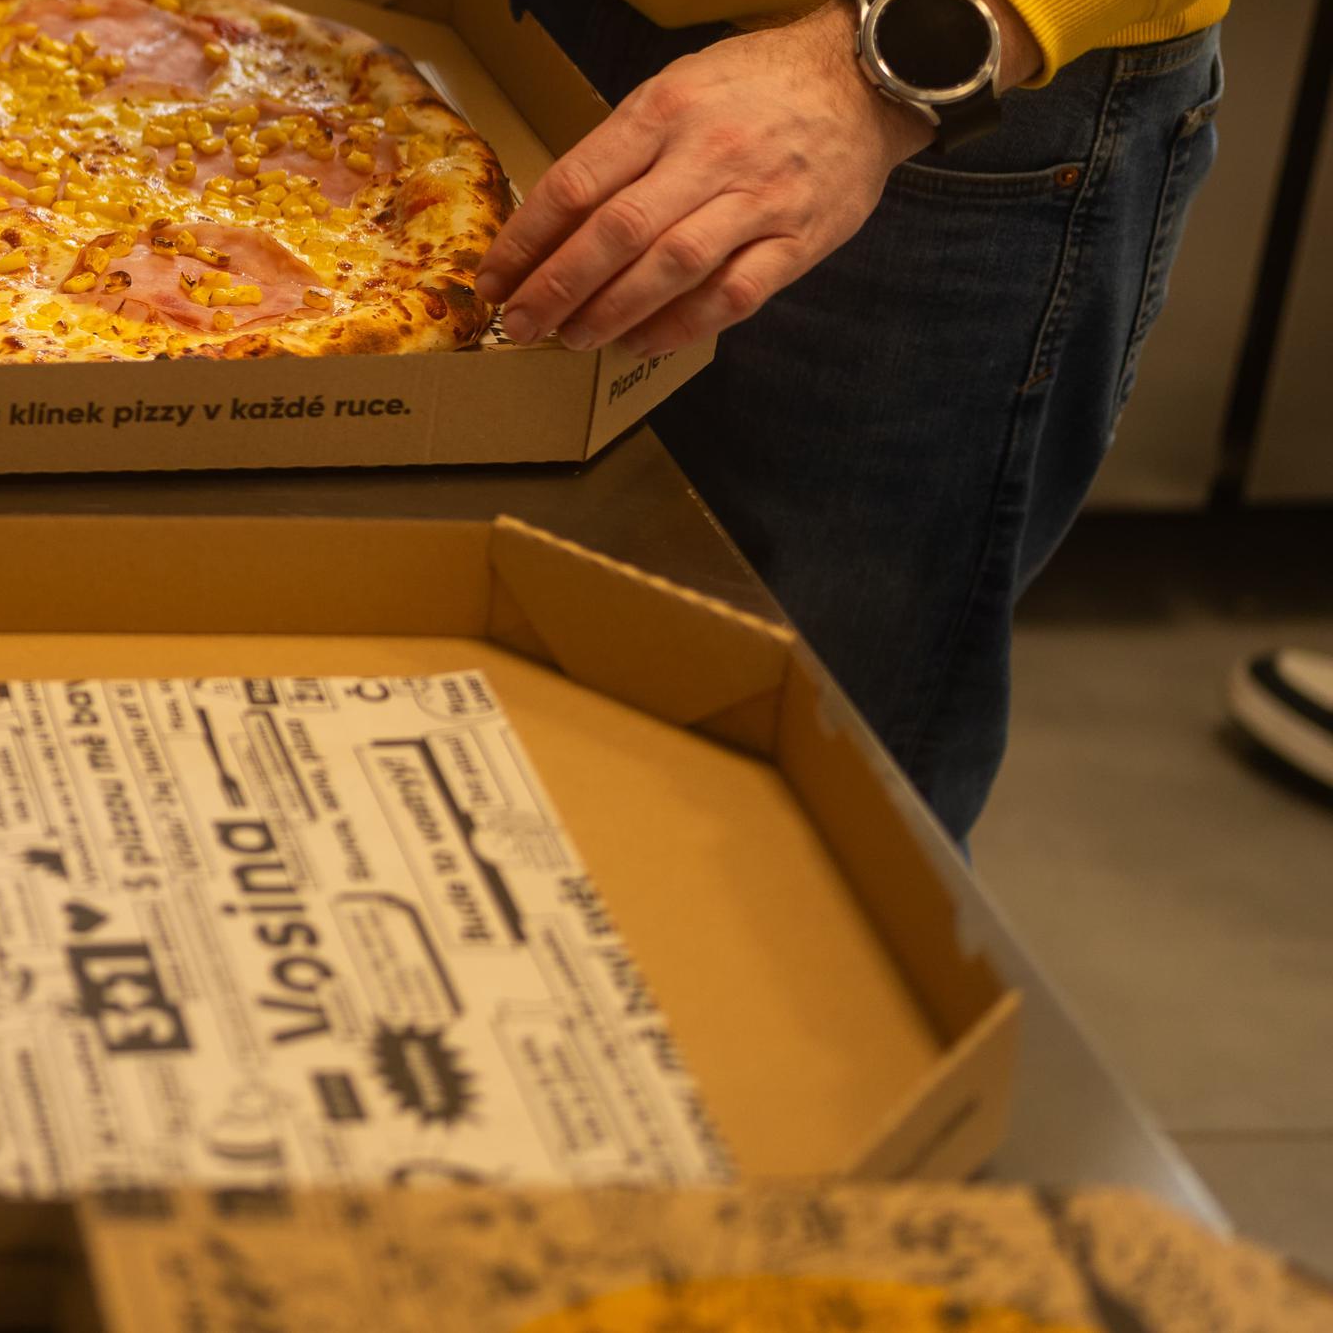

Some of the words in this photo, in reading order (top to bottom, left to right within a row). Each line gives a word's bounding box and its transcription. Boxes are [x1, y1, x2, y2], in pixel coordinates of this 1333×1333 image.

[8, 401, 104, 427] klínek
[112, 400, 194, 428] pizzy
[202, 403, 222, 421] v
[229, 395, 325, 420] každé
[333, 397, 411, 417] ruce.
[213, 819, 334, 1046] Vosina
